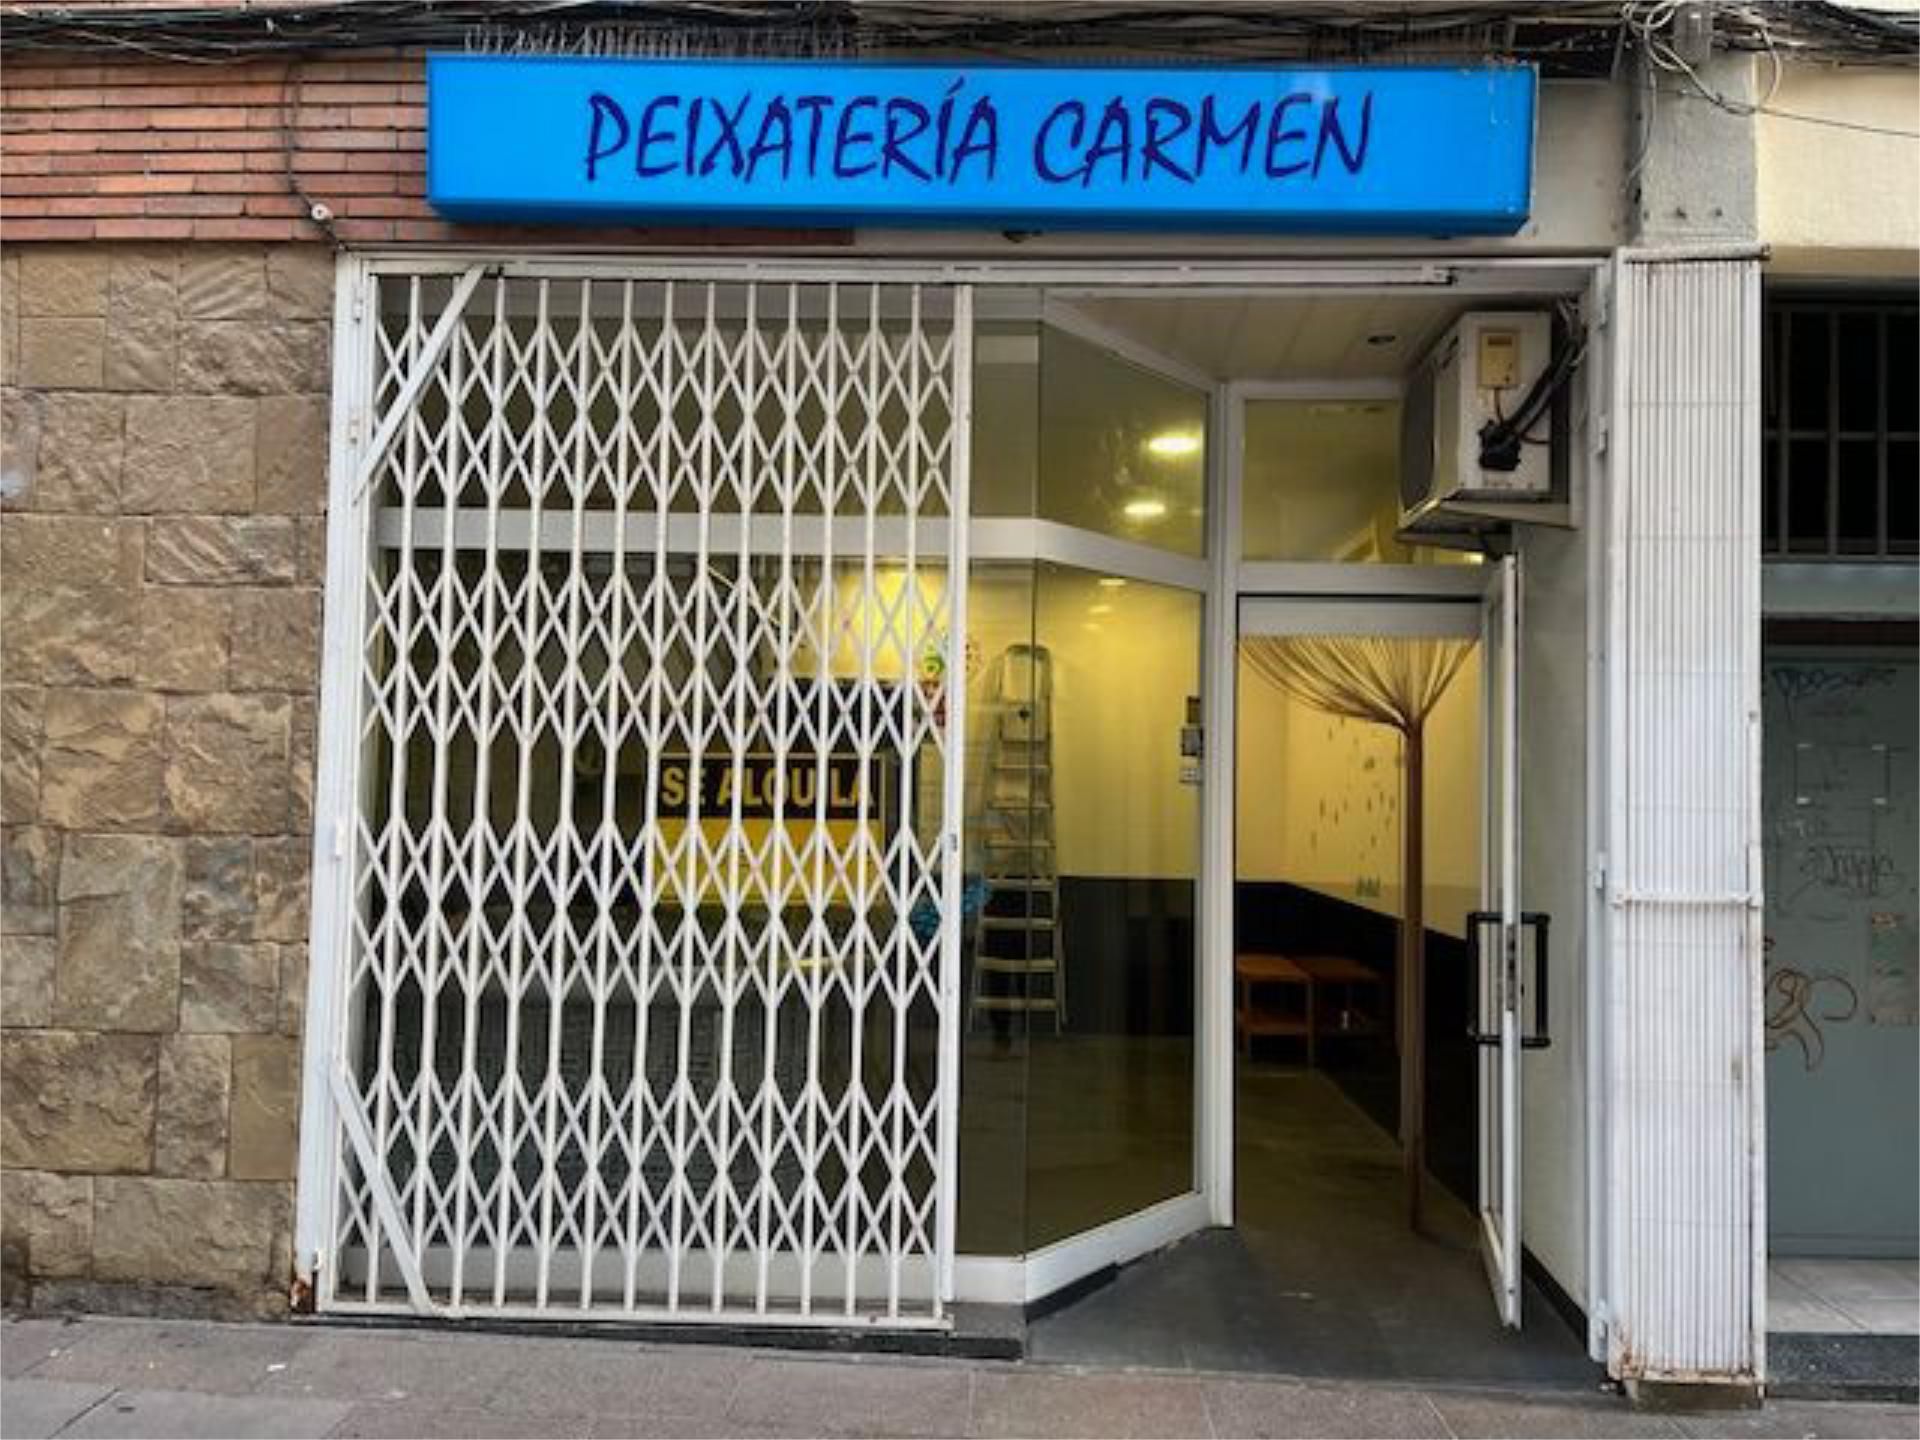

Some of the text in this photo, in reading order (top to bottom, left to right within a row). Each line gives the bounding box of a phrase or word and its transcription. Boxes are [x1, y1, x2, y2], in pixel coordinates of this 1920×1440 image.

[584, 76, 1373, 188] PEIXATERÍA CARMEN
[716, 766, 876, 807] ALQULA
